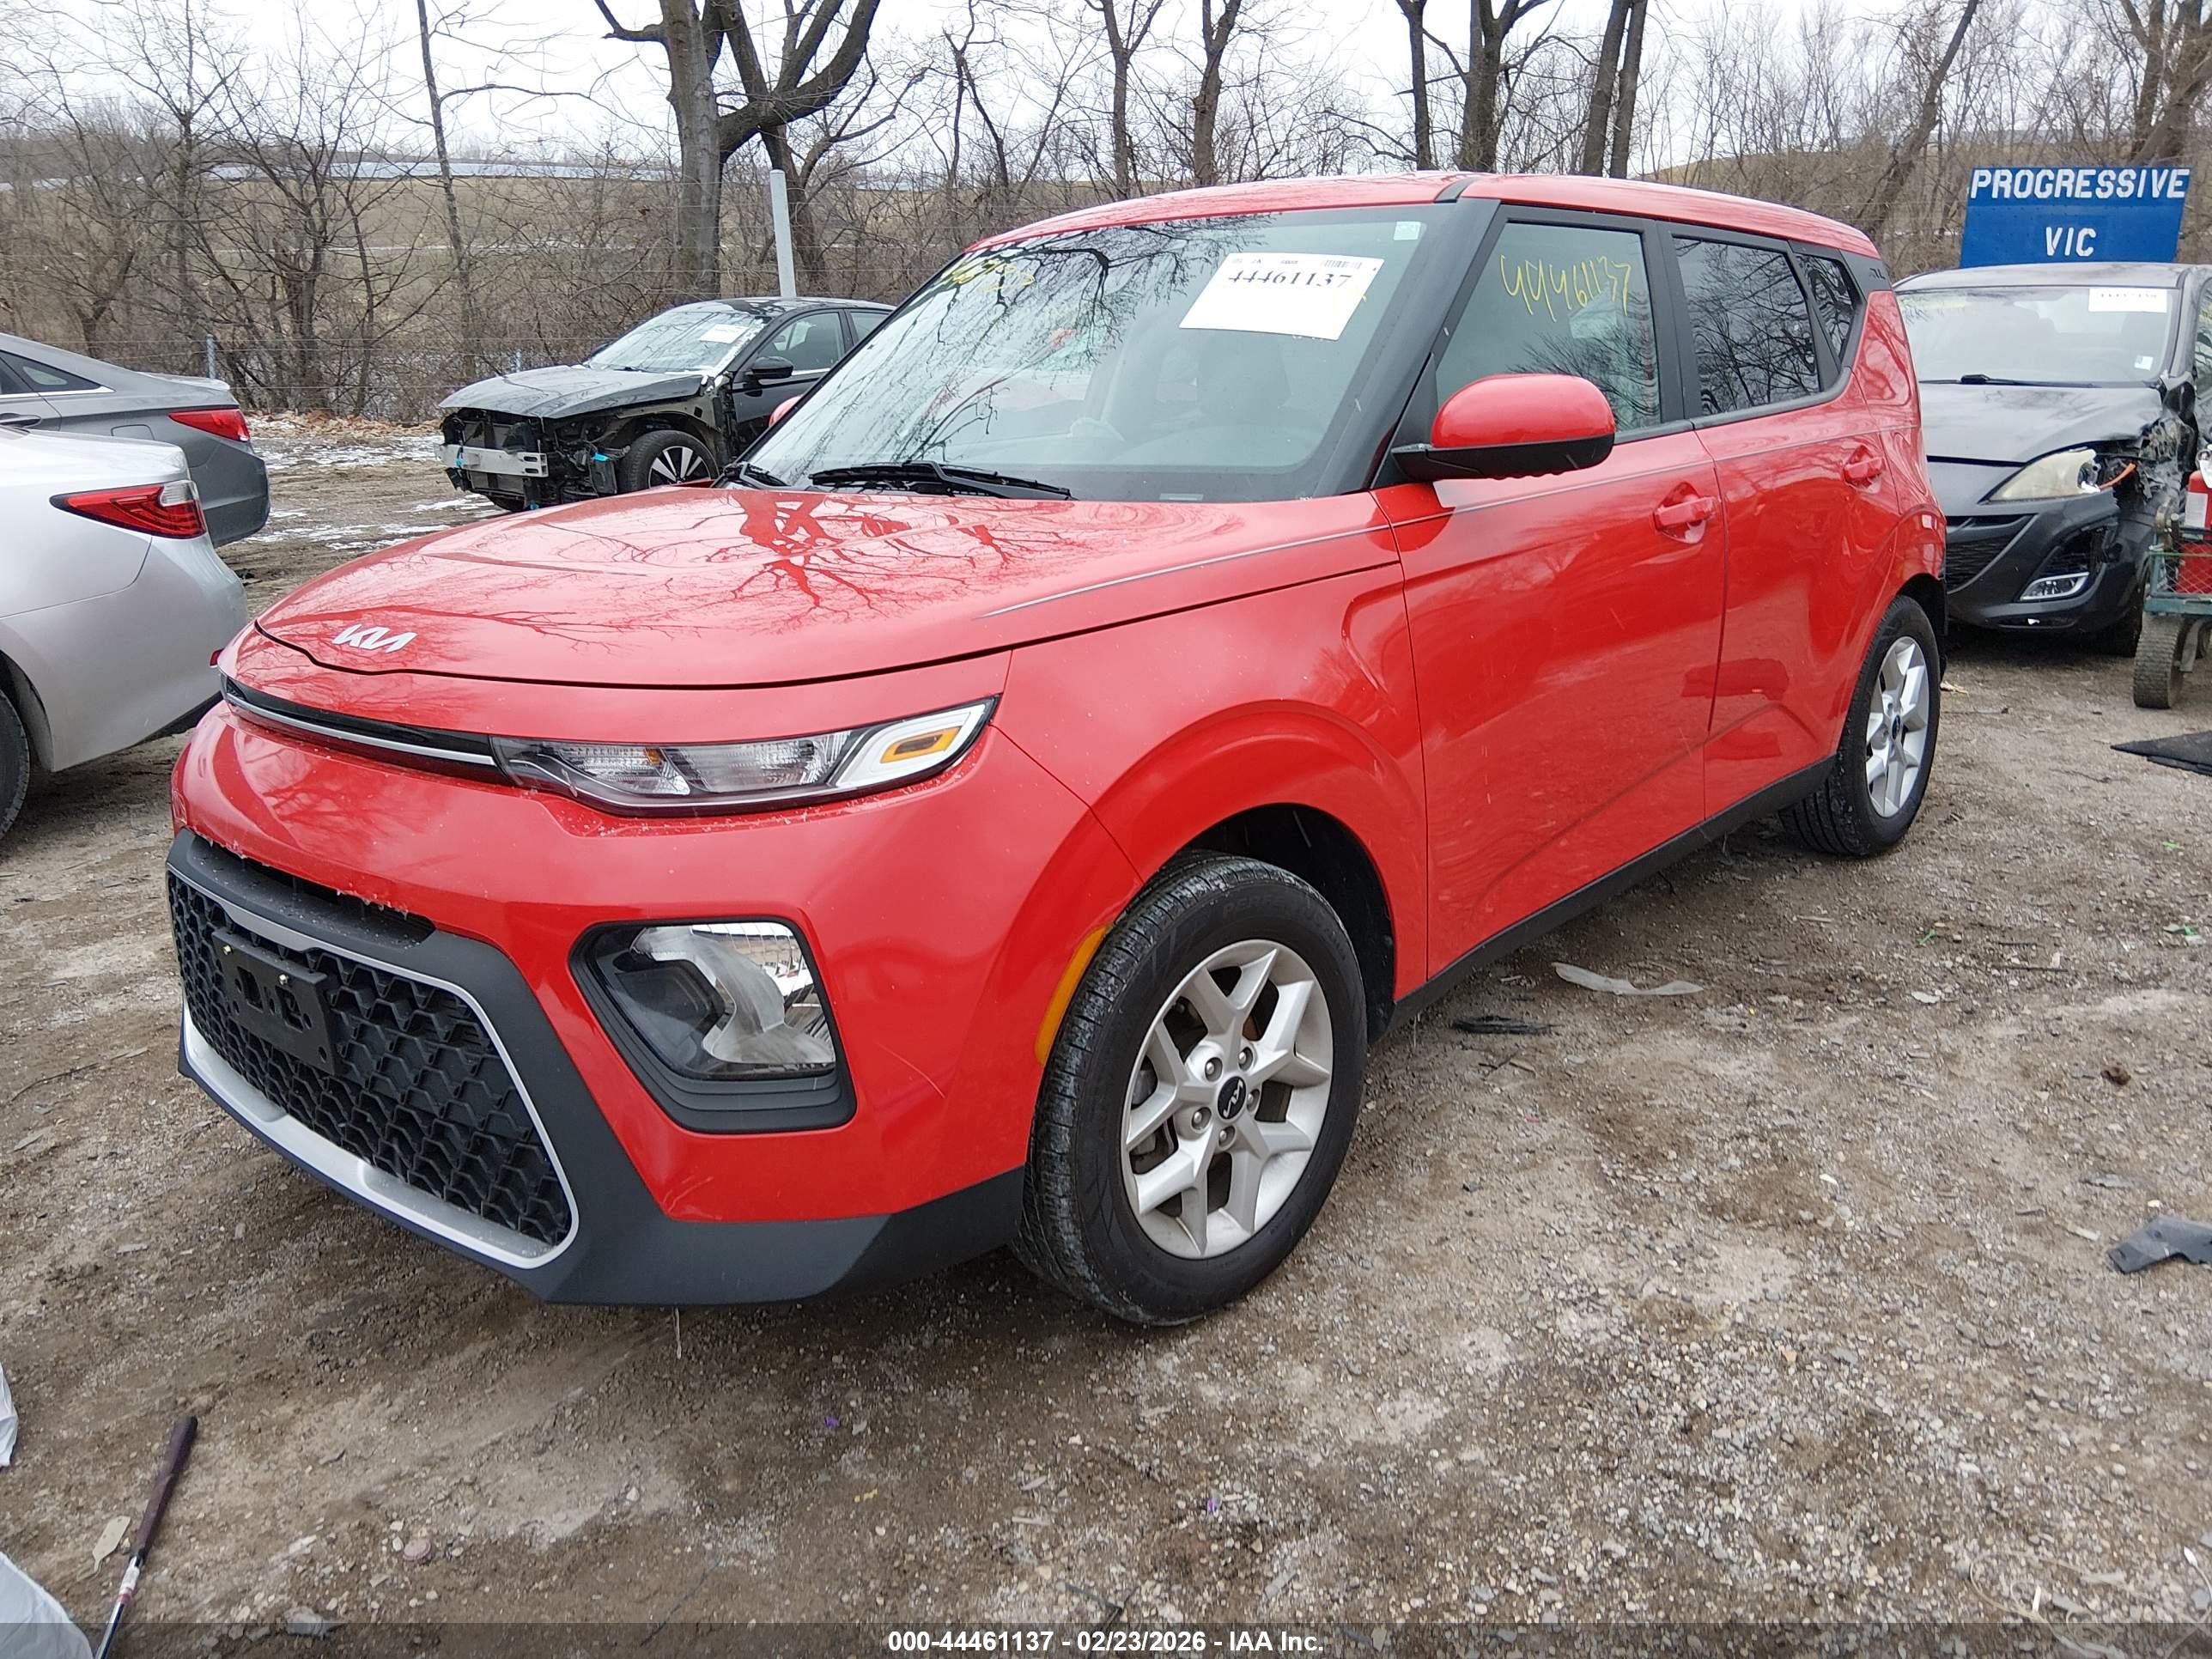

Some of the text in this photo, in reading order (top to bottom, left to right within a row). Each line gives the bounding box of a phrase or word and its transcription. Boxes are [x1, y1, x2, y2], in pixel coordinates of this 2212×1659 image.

[1970, 168, 2191, 199] PROGRESSIVE
[2045, 227, 2097, 257] VIC
[1228, 270, 1353, 288] 44461137
[331, 623, 418, 653] KIA
